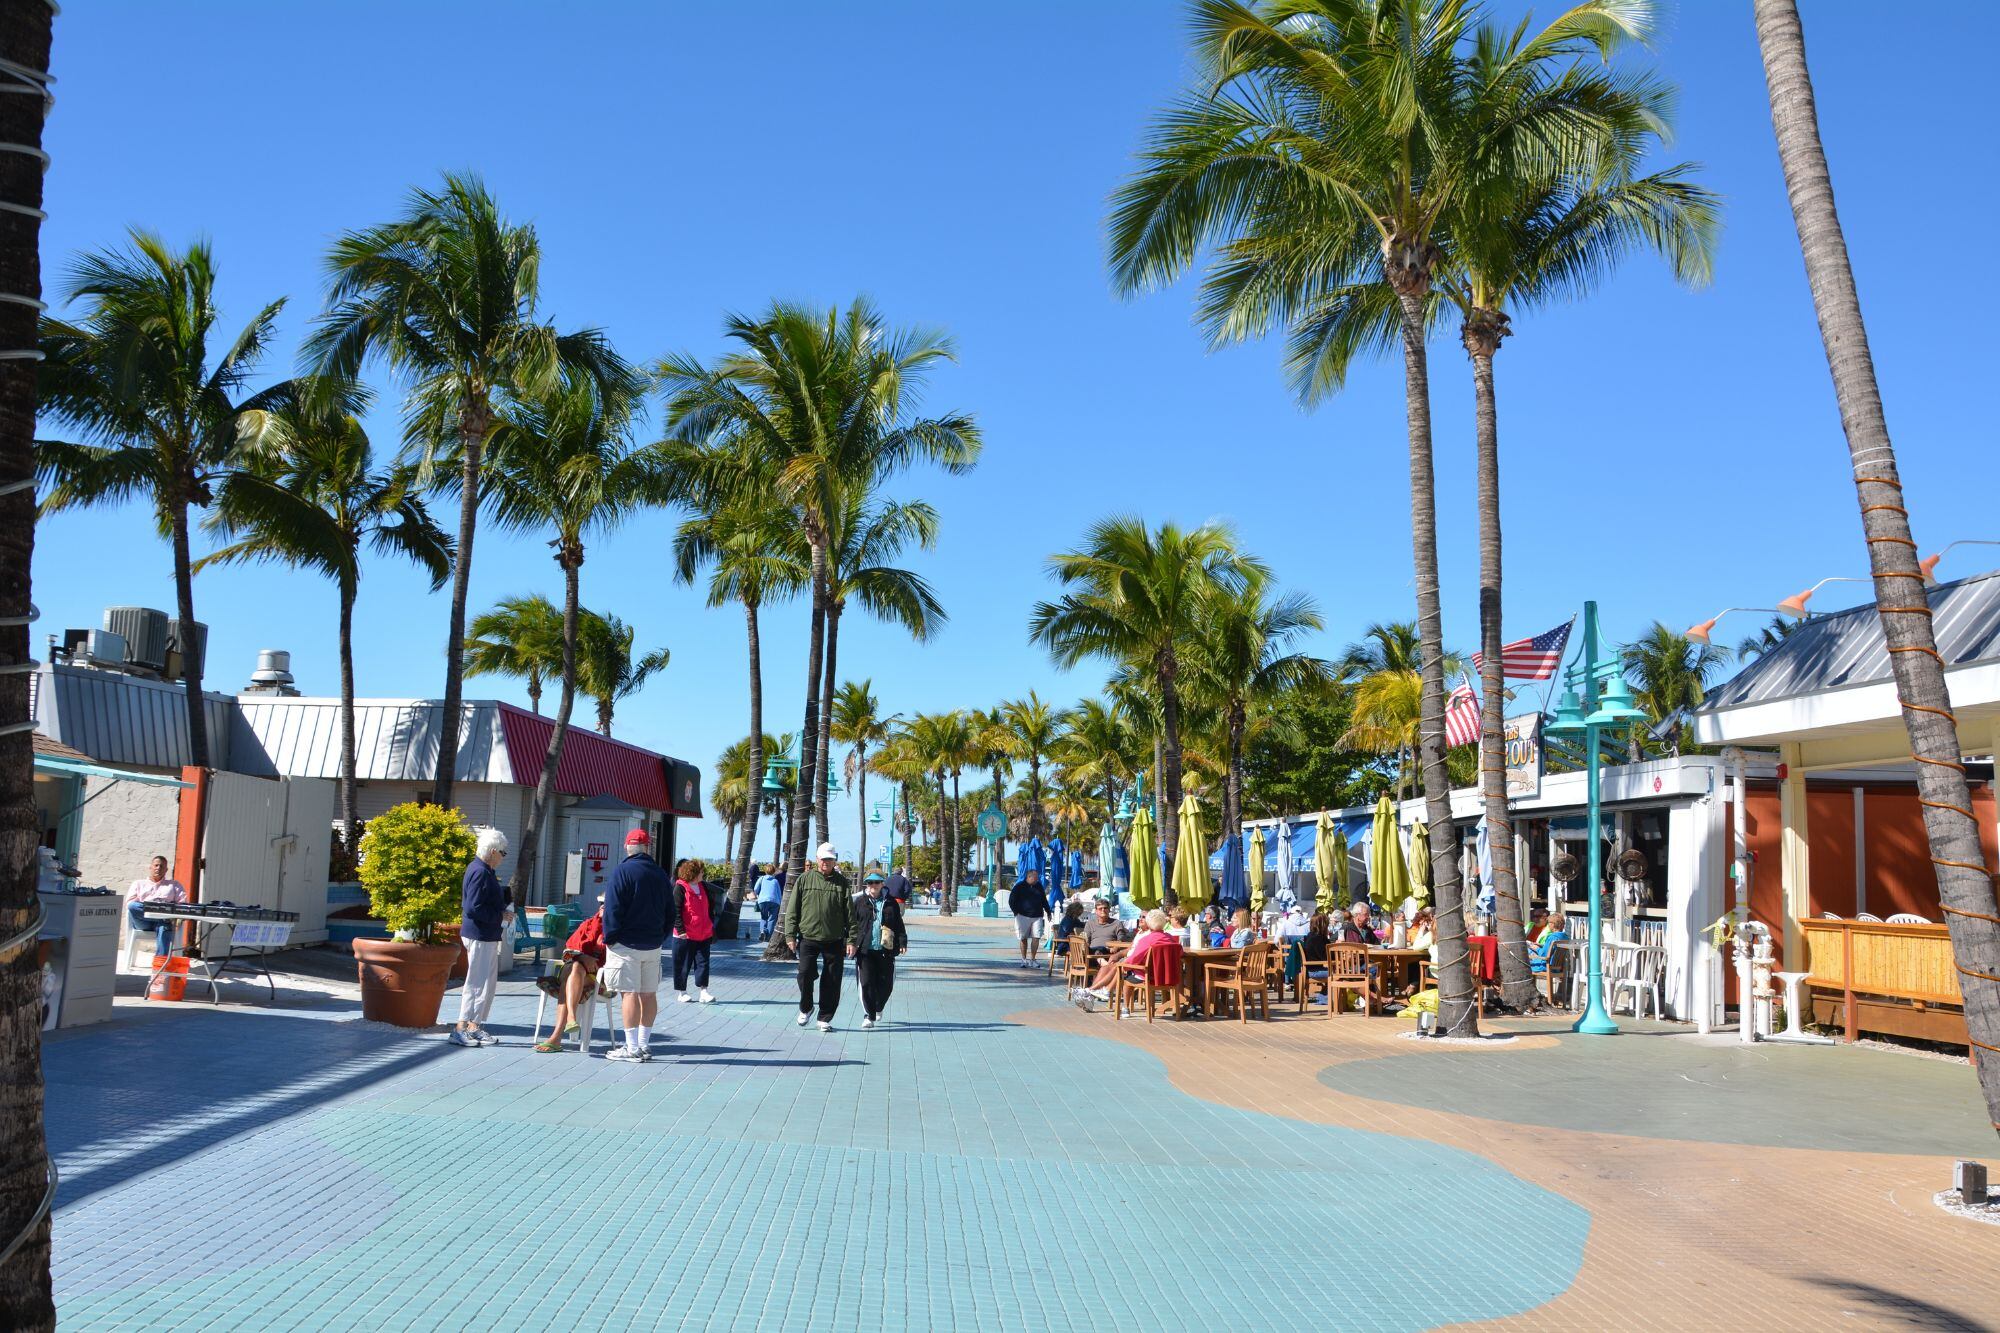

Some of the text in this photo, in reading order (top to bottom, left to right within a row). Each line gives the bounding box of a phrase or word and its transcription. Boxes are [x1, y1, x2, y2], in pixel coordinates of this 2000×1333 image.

[1511, 738, 1537, 766] OUT
[588, 846, 608, 859] ATM
[79, 908, 118, 917] GLASS ARTISAN
